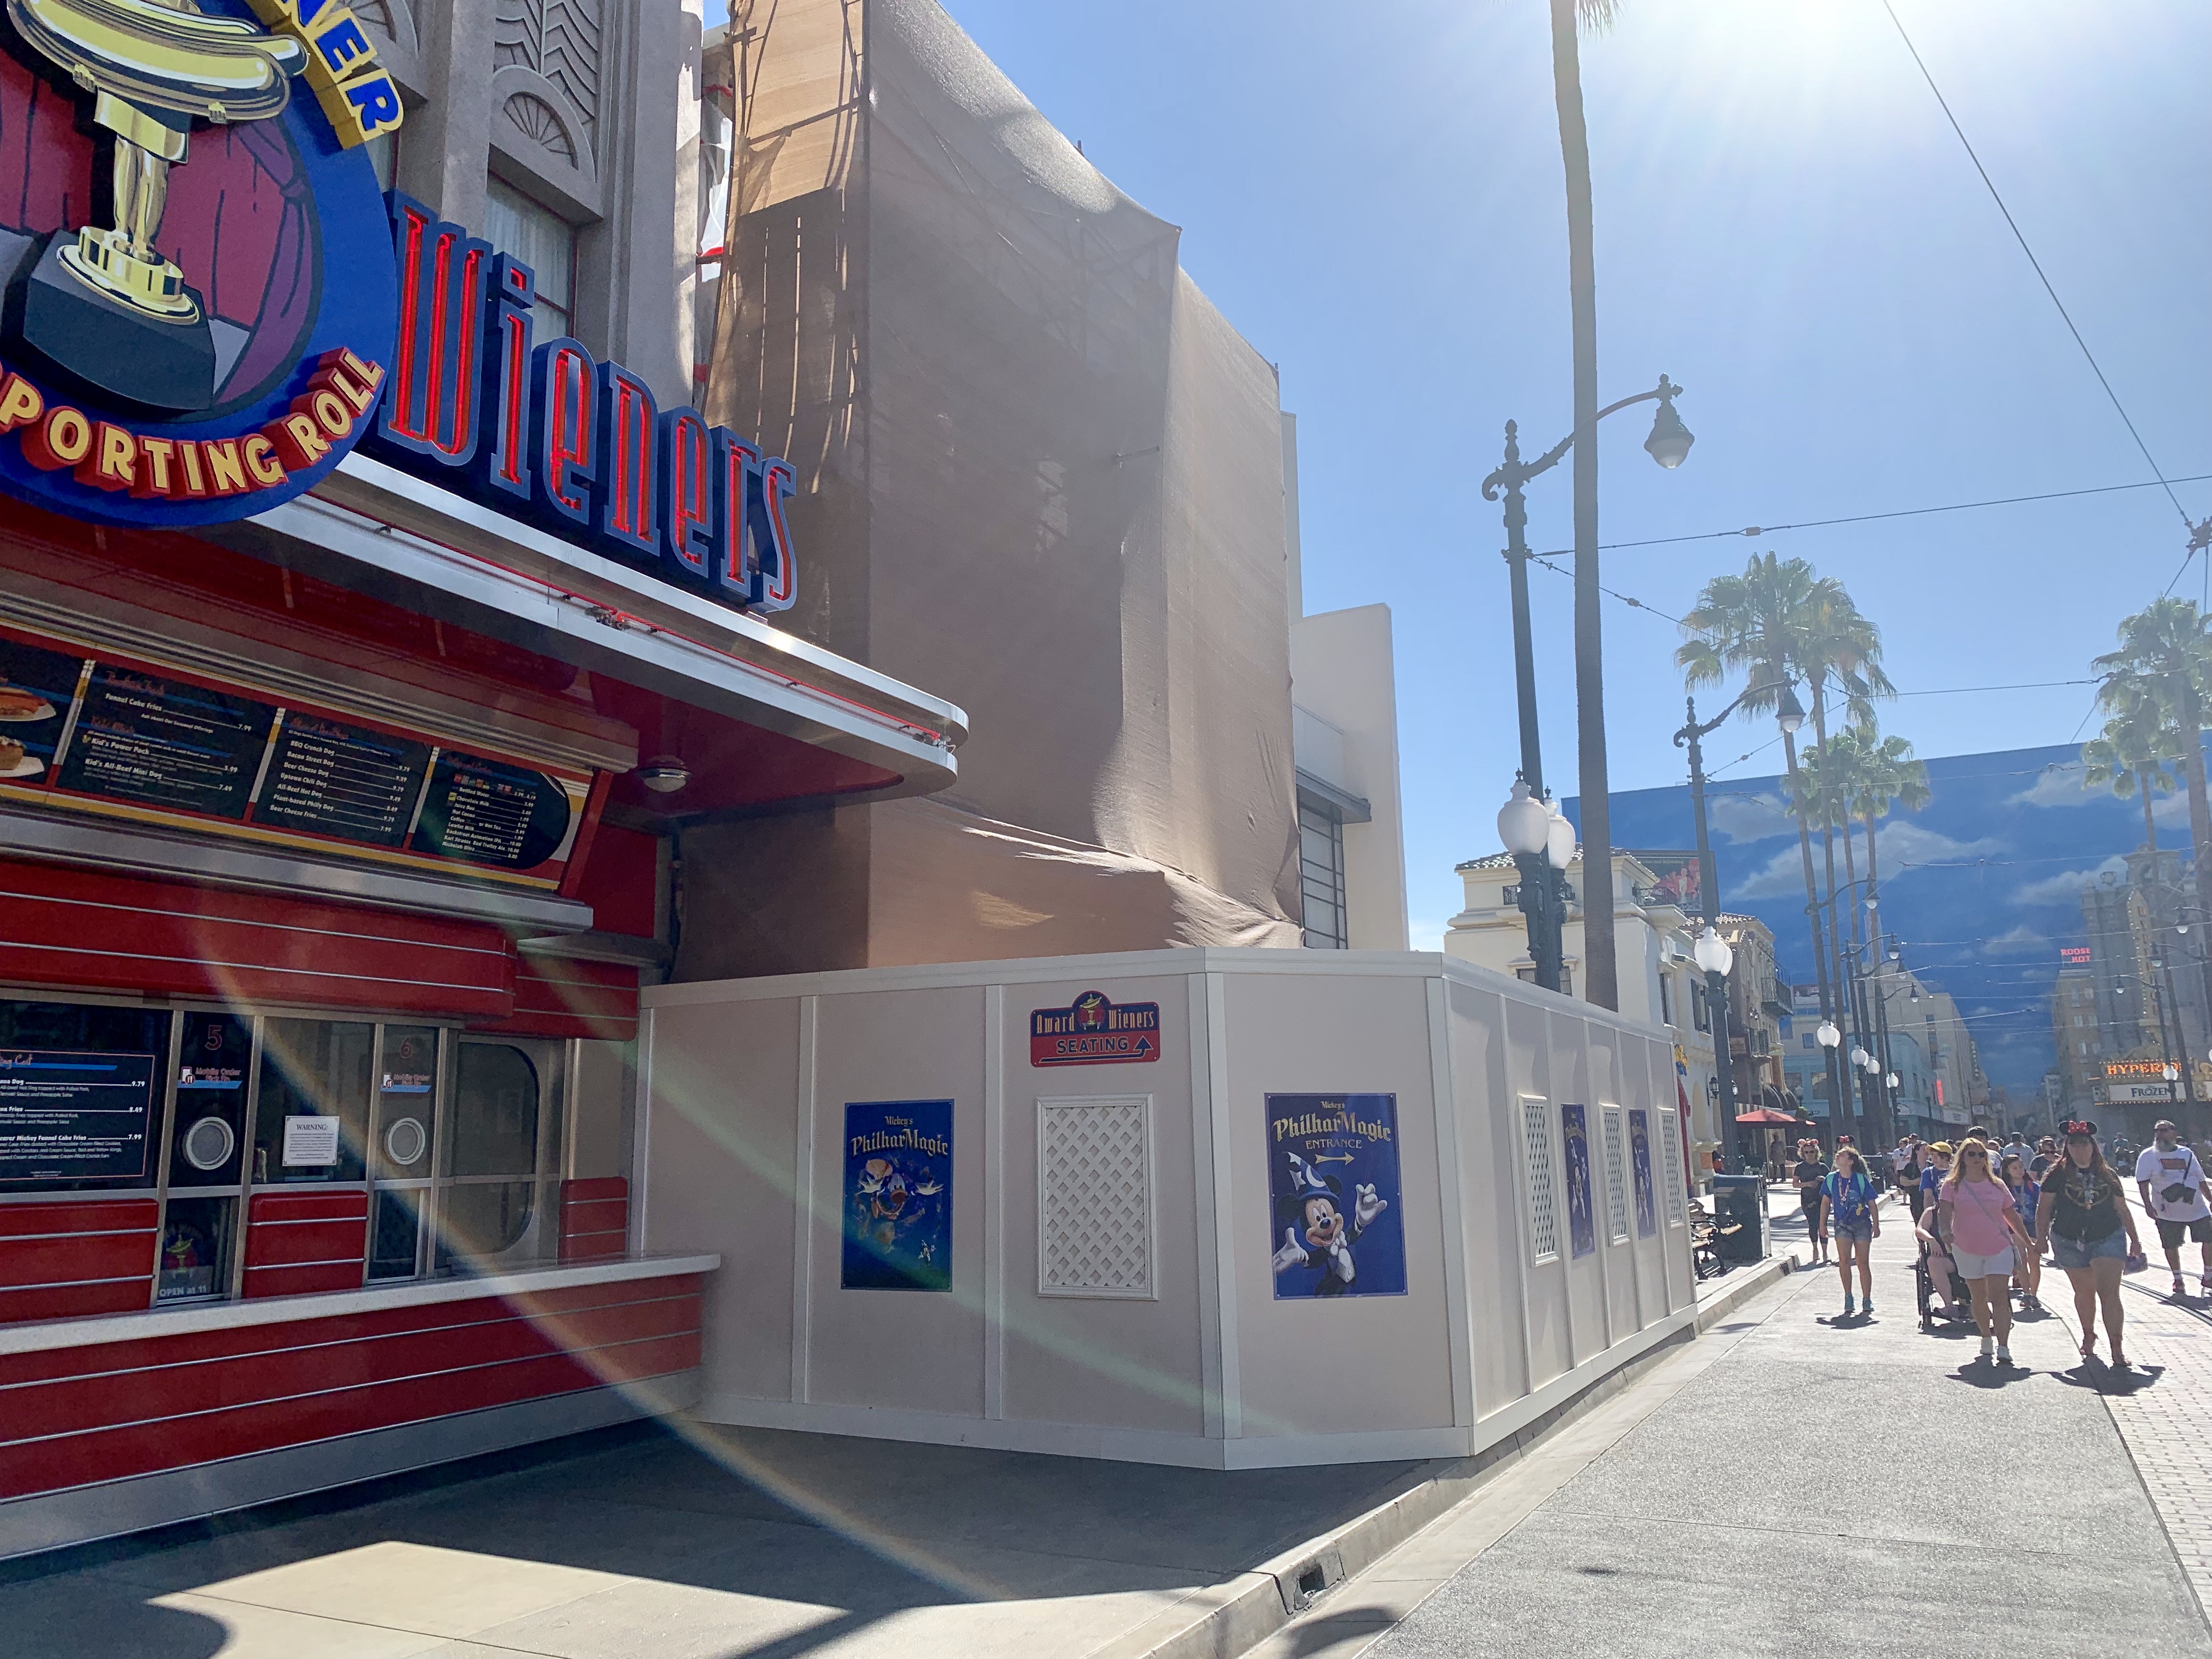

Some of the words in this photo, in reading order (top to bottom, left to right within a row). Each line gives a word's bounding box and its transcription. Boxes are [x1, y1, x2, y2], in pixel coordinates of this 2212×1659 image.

[286, 348, 384, 464] ROLL
[377, 191, 798, 613] Wieners
[290, 740, 303, 748] BBQ
[323, 748, 335, 757] Dog
[323, 759, 334, 768] Dog
[318, 769, 329, 778] Dog
[315, 780, 328, 788] Dog
[311, 790, 322, 798] Dog
[323, 804, 334, 812] Dog
[1036, 1012, 1076, 1035] Award
[1108, 1008, 1154, 1030] Wieners
[205, 1024, 222, 1051] 5
[399, 1036, 413, 1059] 6
[1056, 1035, 1130, 1055] SEATING
[2130, 1086, 2171, 1098] FROZEN
[1320, 1100, 1346, 1110] Mickey's
[884, 1115, 913, 1127] Mickey's
[1272, 1111, 1391, 1143] PhilharMagic
[850, 1128, 949, 1158] PhilharMagic
[1305, 1138, 1363, 1150] ENTRANCE
